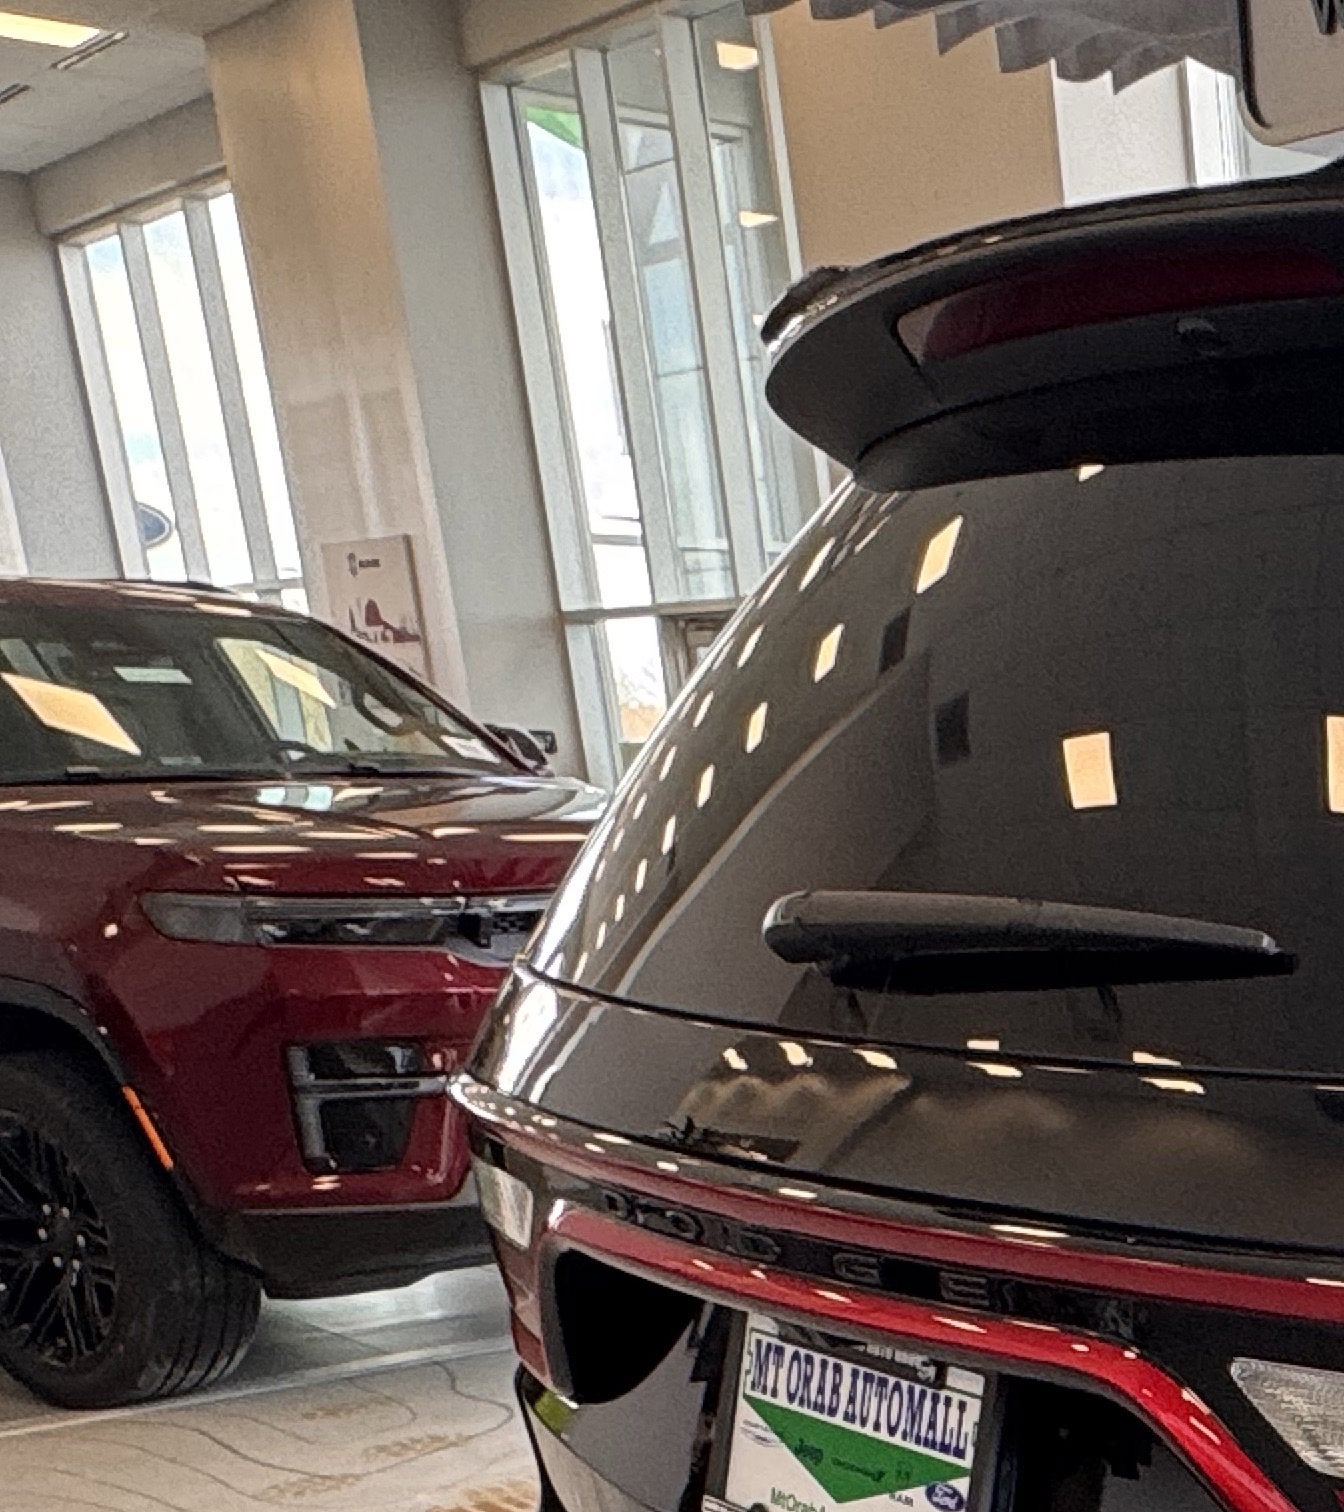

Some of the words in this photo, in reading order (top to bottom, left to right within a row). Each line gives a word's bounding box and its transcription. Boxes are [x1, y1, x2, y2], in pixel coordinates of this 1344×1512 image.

[750, 1338, 785, 1399] MT
[786, 1350, 844, 1418] ORAB
[843, 1367, 970, 1460] AUTOMALL
